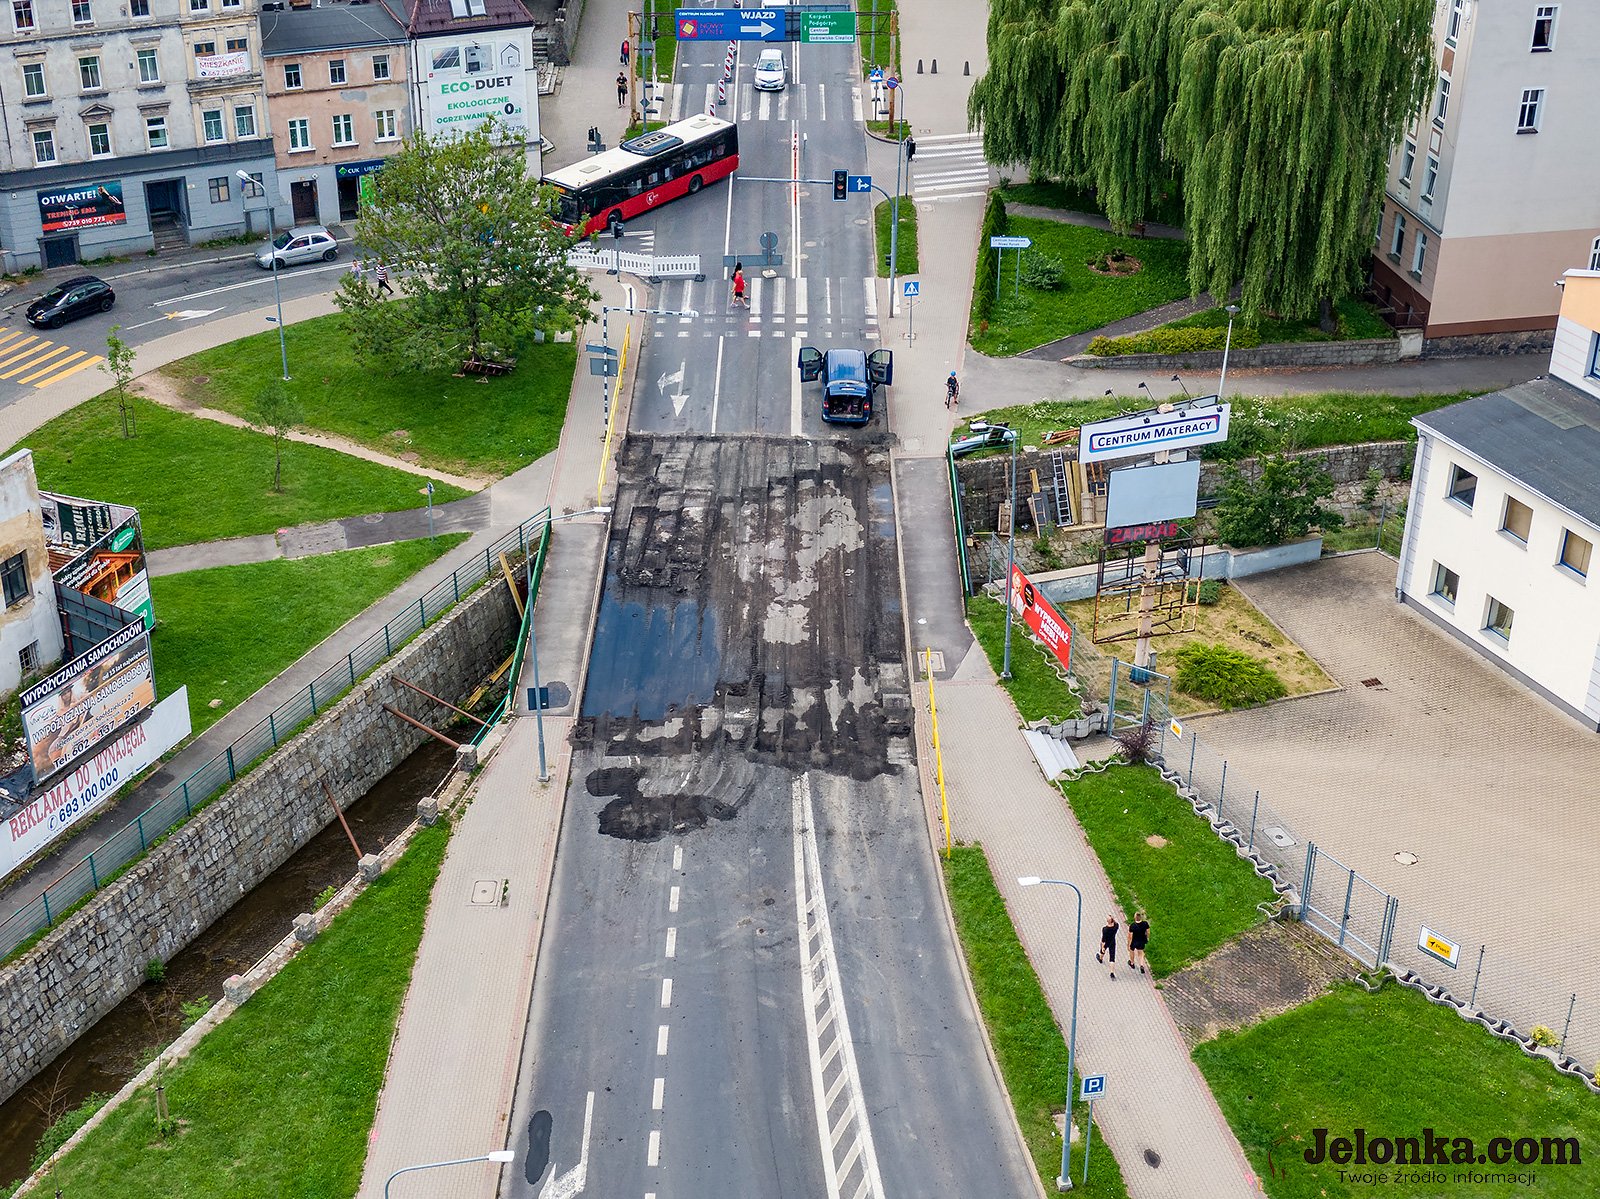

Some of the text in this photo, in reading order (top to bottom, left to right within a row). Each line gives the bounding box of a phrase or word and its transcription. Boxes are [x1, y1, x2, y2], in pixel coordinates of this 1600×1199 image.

[740, 11, 776, 20] WJAZD
[199, 57, 244, 69] MIESZKANIE
[441, 76, 513, 94] ECO-DUET
[447, 96, 510, 110] EKOLOGICZNE
[491, 110, 503, 119] ZA
[504, 103, 515, 115] 0
[41, 190, 96, 205] OTWARTE!
[47, 206, 97, 219] TRENING EMS
[1097, 421, 1212, 447] CENTRUM MATERACY
[1040, 620, 1059, 644] MEBLI
[23, 621, 144, 706] WYPOŻYCZALNIA SAMOCHODÓW
[102, 673, 109, 681] od
[109, 669, 116, 677] 15
[32, 696, 96, 745] WYPOŻYCZALNIA
[96, 660, 150, 702] SAMOCHODÓW
[53, 755, 71, 768] Tel:
[72, 740, 90, 756] 602
[123, 702, 141, 719] 237
[8, 780, 73, 842] REKLAMA
[75, 765, 91, 791] DO
[93, 723, 147, 777] WYNAJĘCIA
[59, 798, 79, 822] 693
[81, 782, 98, 806] 100
[100, 767, 119, 791] 000
